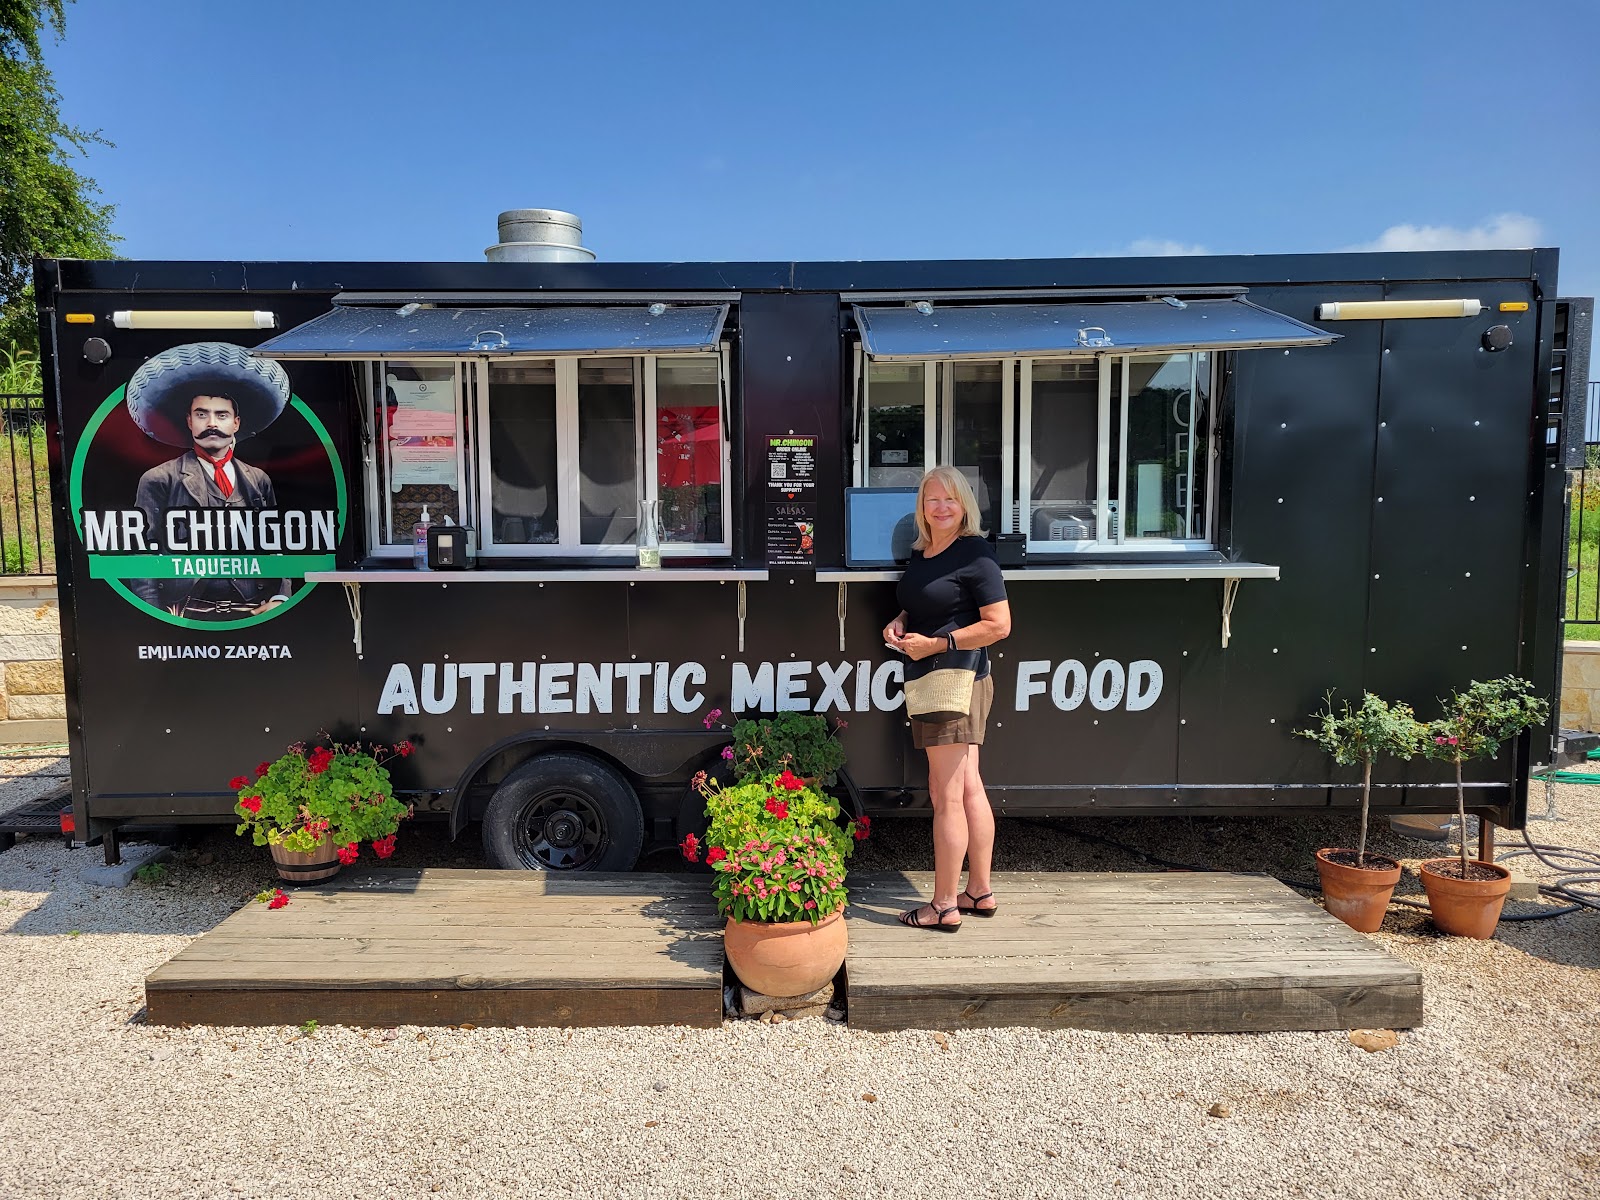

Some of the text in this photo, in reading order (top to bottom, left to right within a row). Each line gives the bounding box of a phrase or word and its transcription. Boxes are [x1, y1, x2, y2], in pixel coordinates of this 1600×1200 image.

[769, 438, 813, 447] MR.CHINGON
[775, 506, 806, 516] SALSAS
[84, 509, 337, 551] MR. CHINGON
[171, 557, 262, 577] TAQUERIA
[138, 645, 293, 660] EMILIANO ZAPATA
[377, 658, 1164, 715] AUTHENTIC MEXIC FOOD
